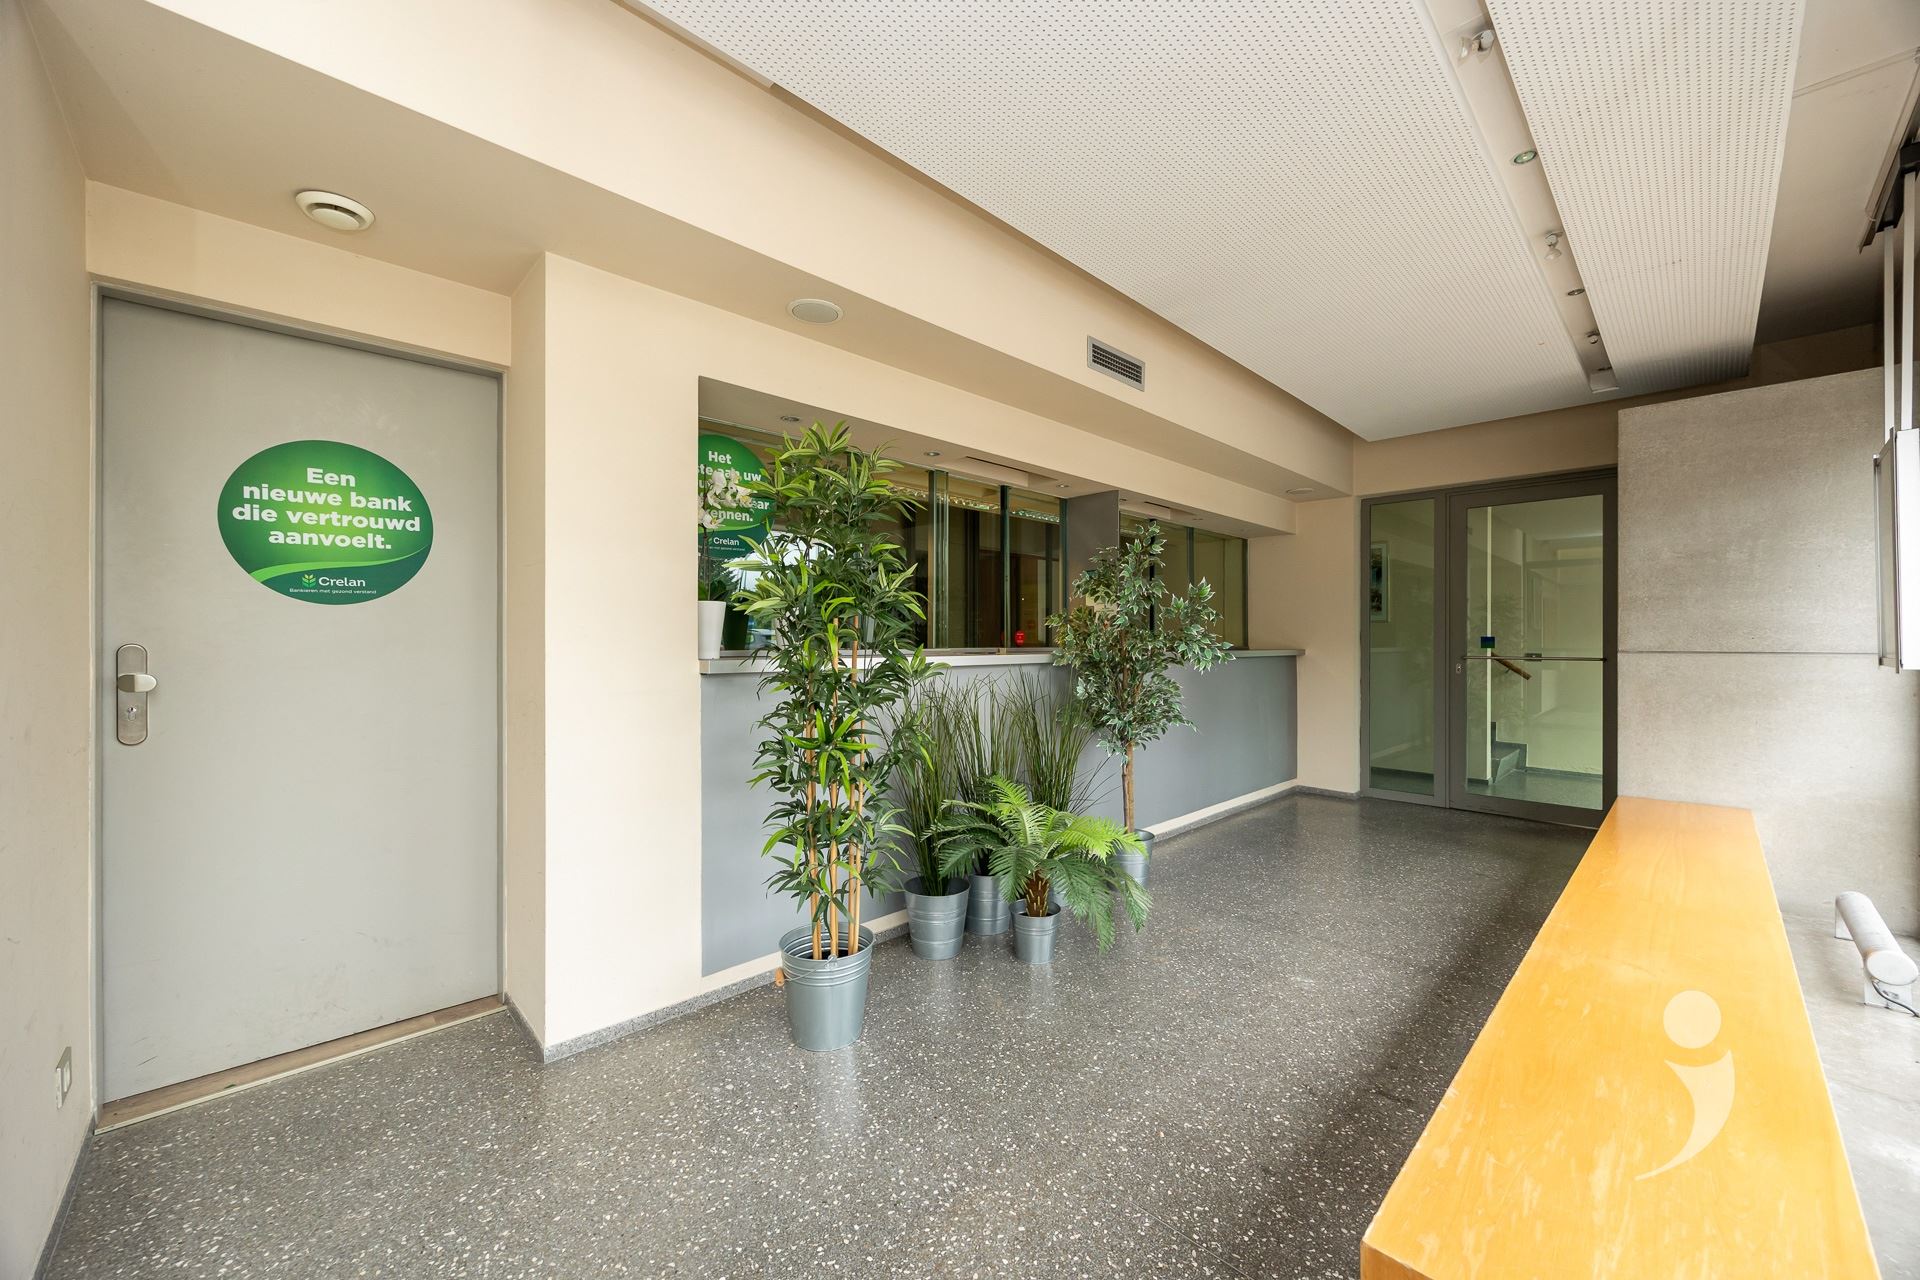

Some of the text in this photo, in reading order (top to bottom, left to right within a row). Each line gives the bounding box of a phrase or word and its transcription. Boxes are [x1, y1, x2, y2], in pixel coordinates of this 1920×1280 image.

[708, 450, 732, 464] Het
[306, 467, 356, 487] Een
[743, 472, 761, 481] uw
[243, 484, 412, 512] nieuwe bank
[232, 503, 421, 532] die vertrouwd
[708, 508, 753, 522] ennen.
[268, 530, 392, 550] aanvoelt.
[713, 536, 740, 546] Crelan
[318, 576, 366, 587] Crelan
